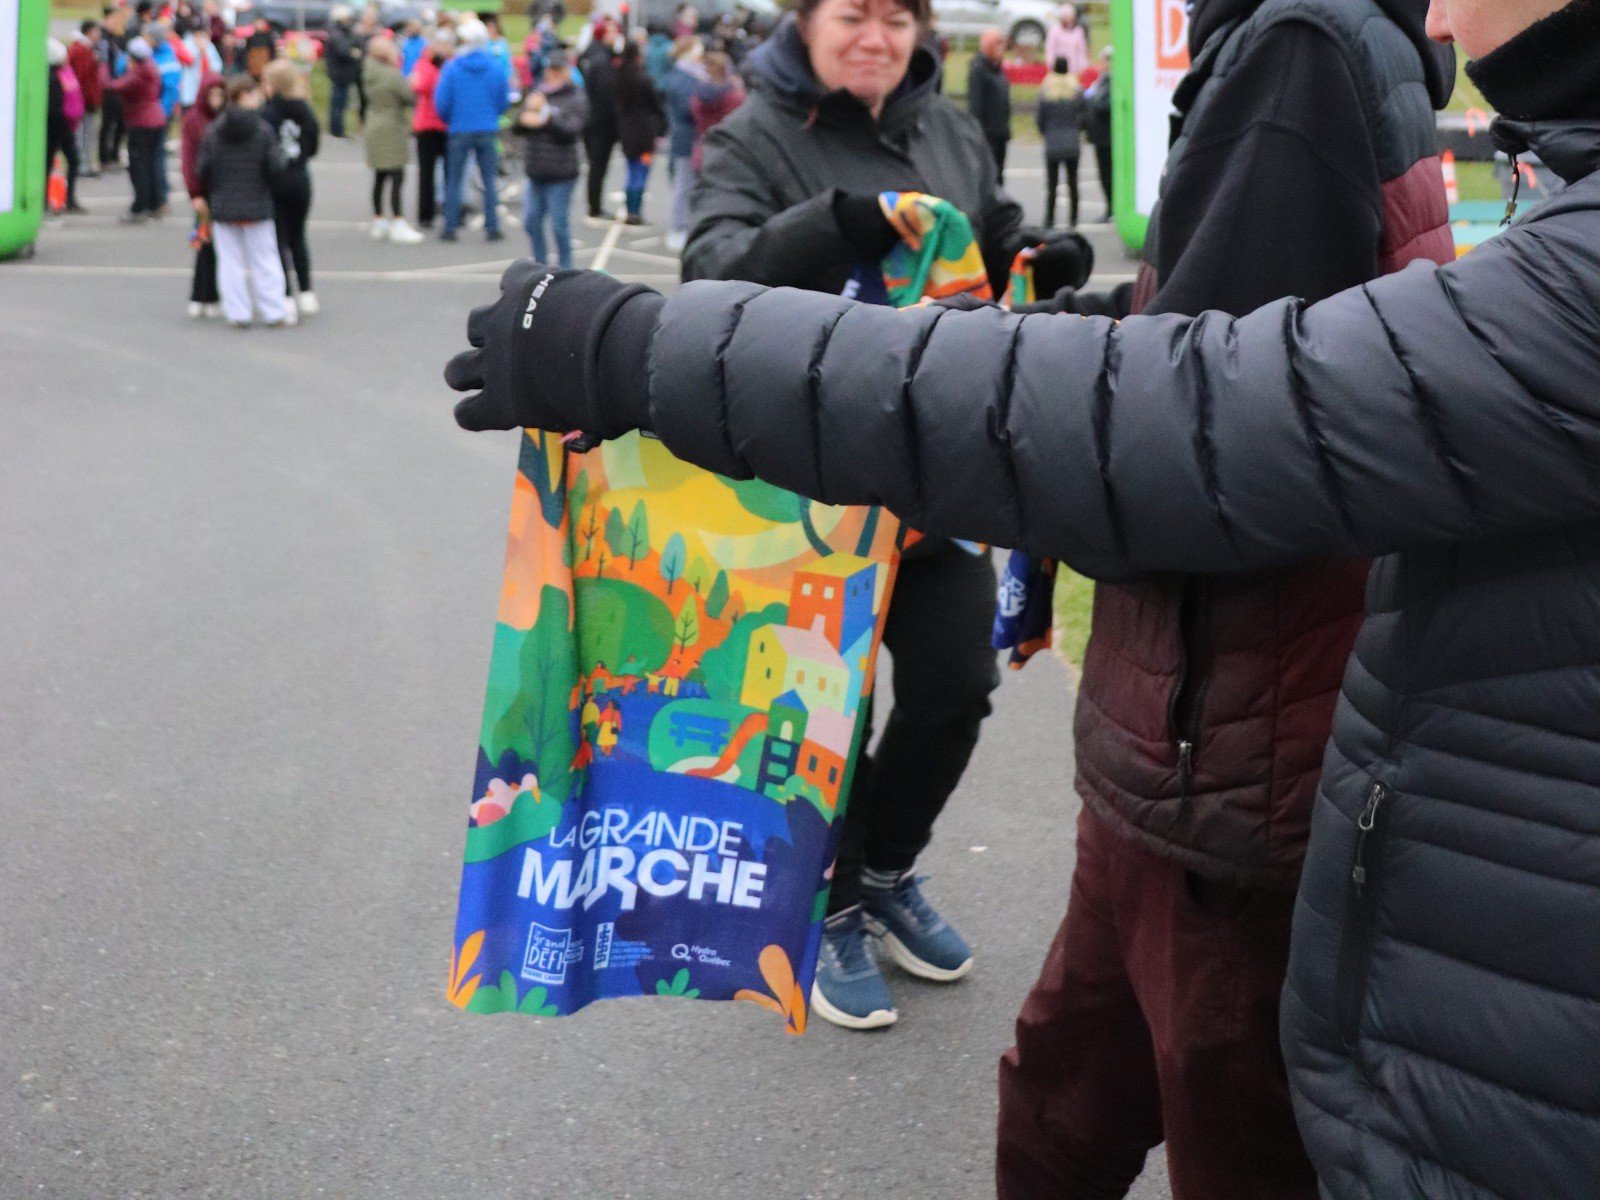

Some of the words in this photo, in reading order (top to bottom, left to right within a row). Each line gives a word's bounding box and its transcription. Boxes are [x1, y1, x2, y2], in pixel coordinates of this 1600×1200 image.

[522, 273, 555, 329] HEAD
[549, 825, 577, 848] LA
[579, 808, 744, 856] GRANDE
[517, 846, 768, 911] MARCHE
